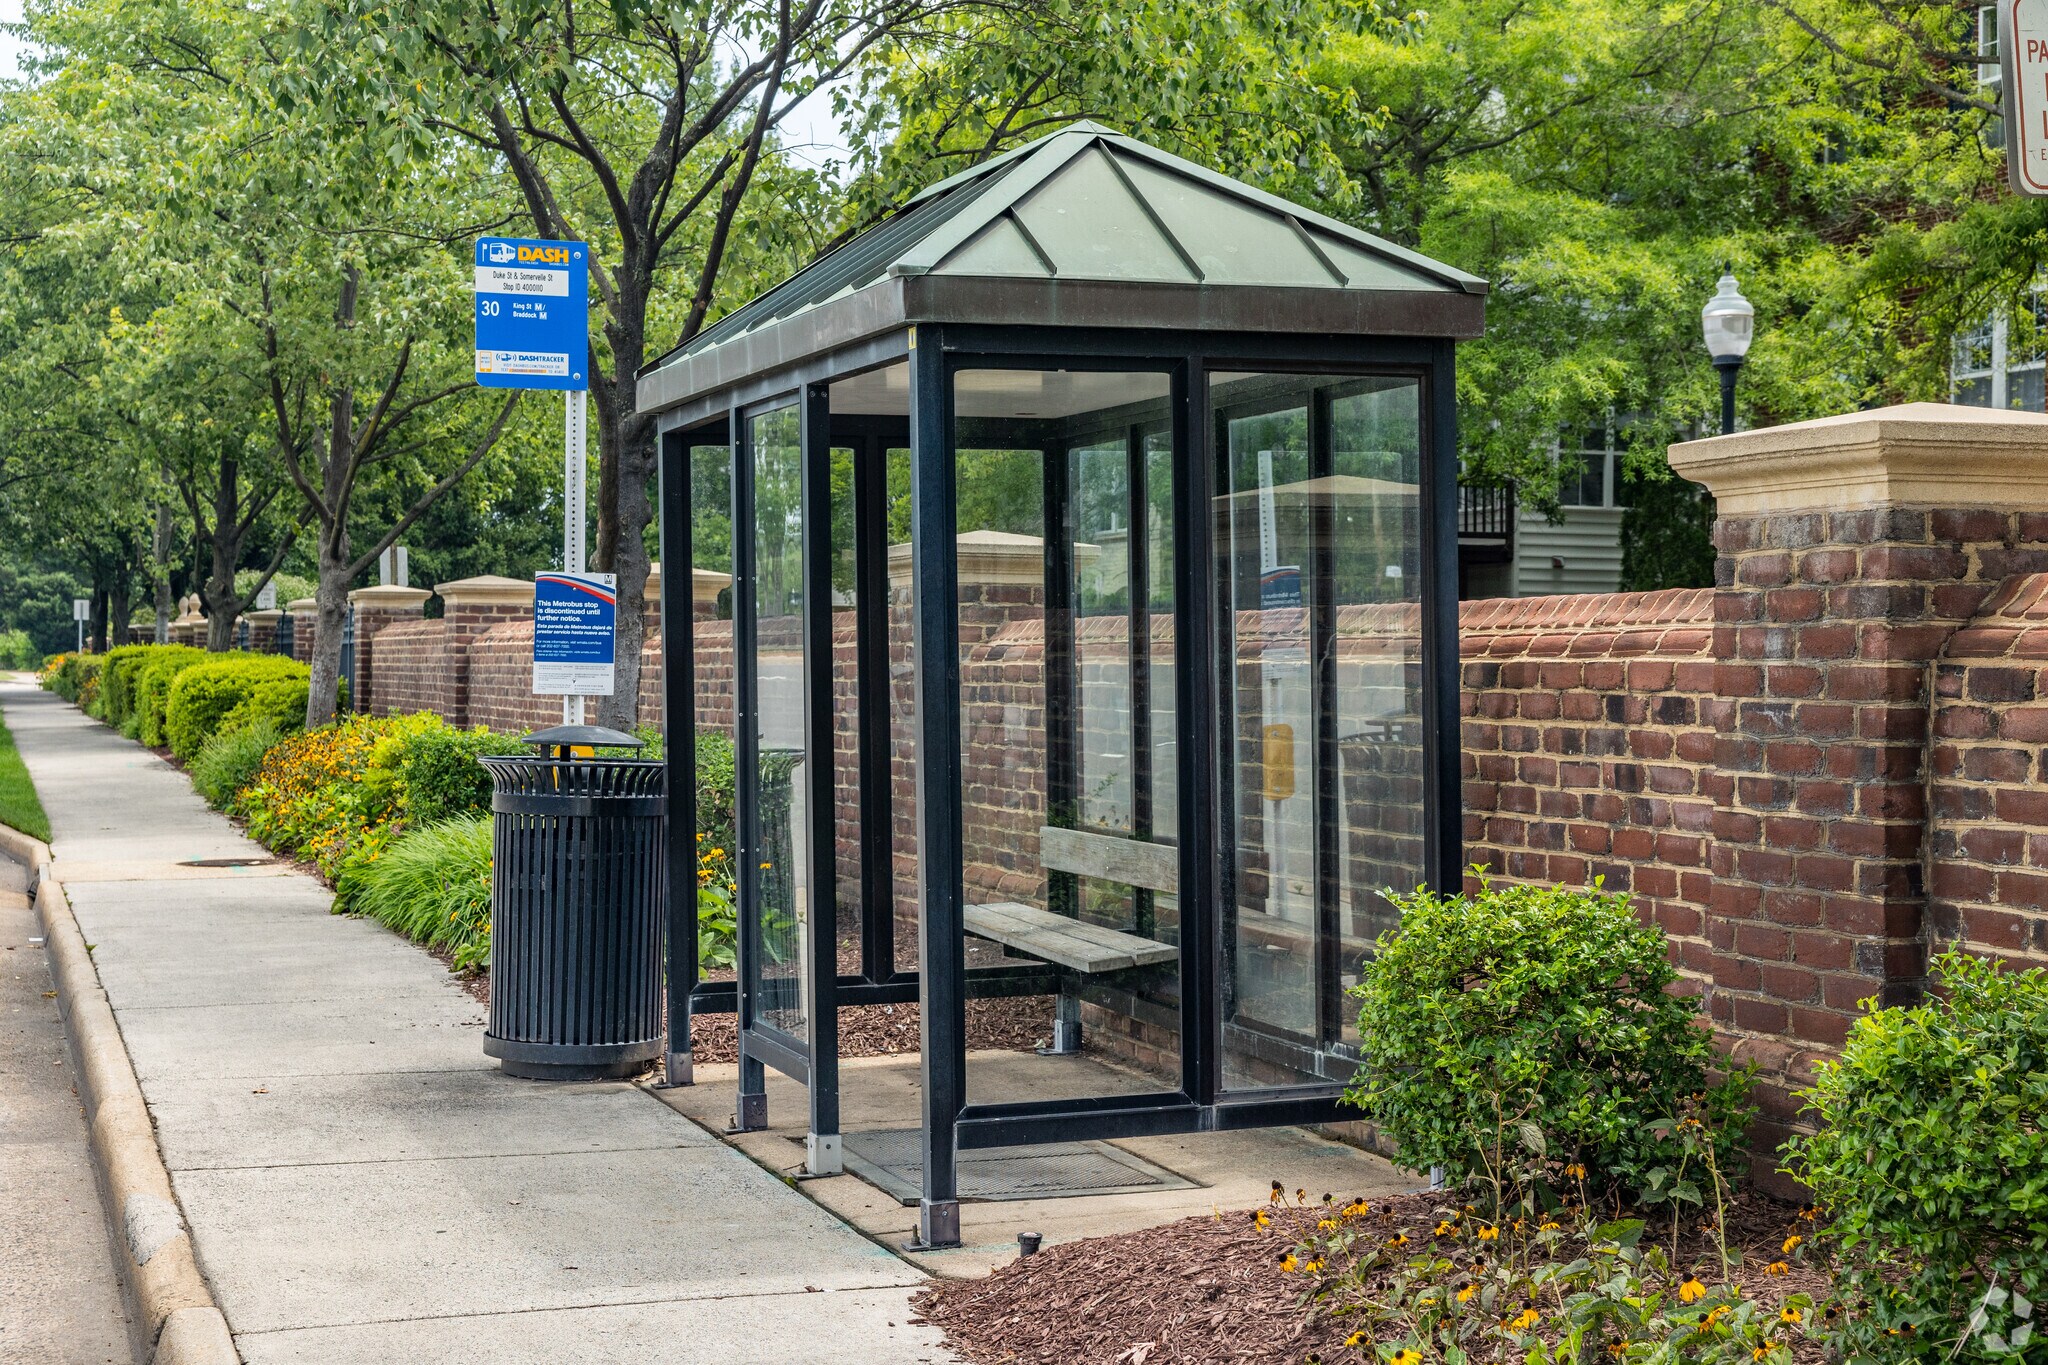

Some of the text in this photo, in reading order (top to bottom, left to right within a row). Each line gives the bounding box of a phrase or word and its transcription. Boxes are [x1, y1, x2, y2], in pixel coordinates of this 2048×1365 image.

[518, 246, 569, 263] DASH
[493, 271, 505, 279] Duke
[520, 273, 546, 281] Somervelle
[503, 283, 514, 291] Stop
[481, 300, 500, 316] 30
